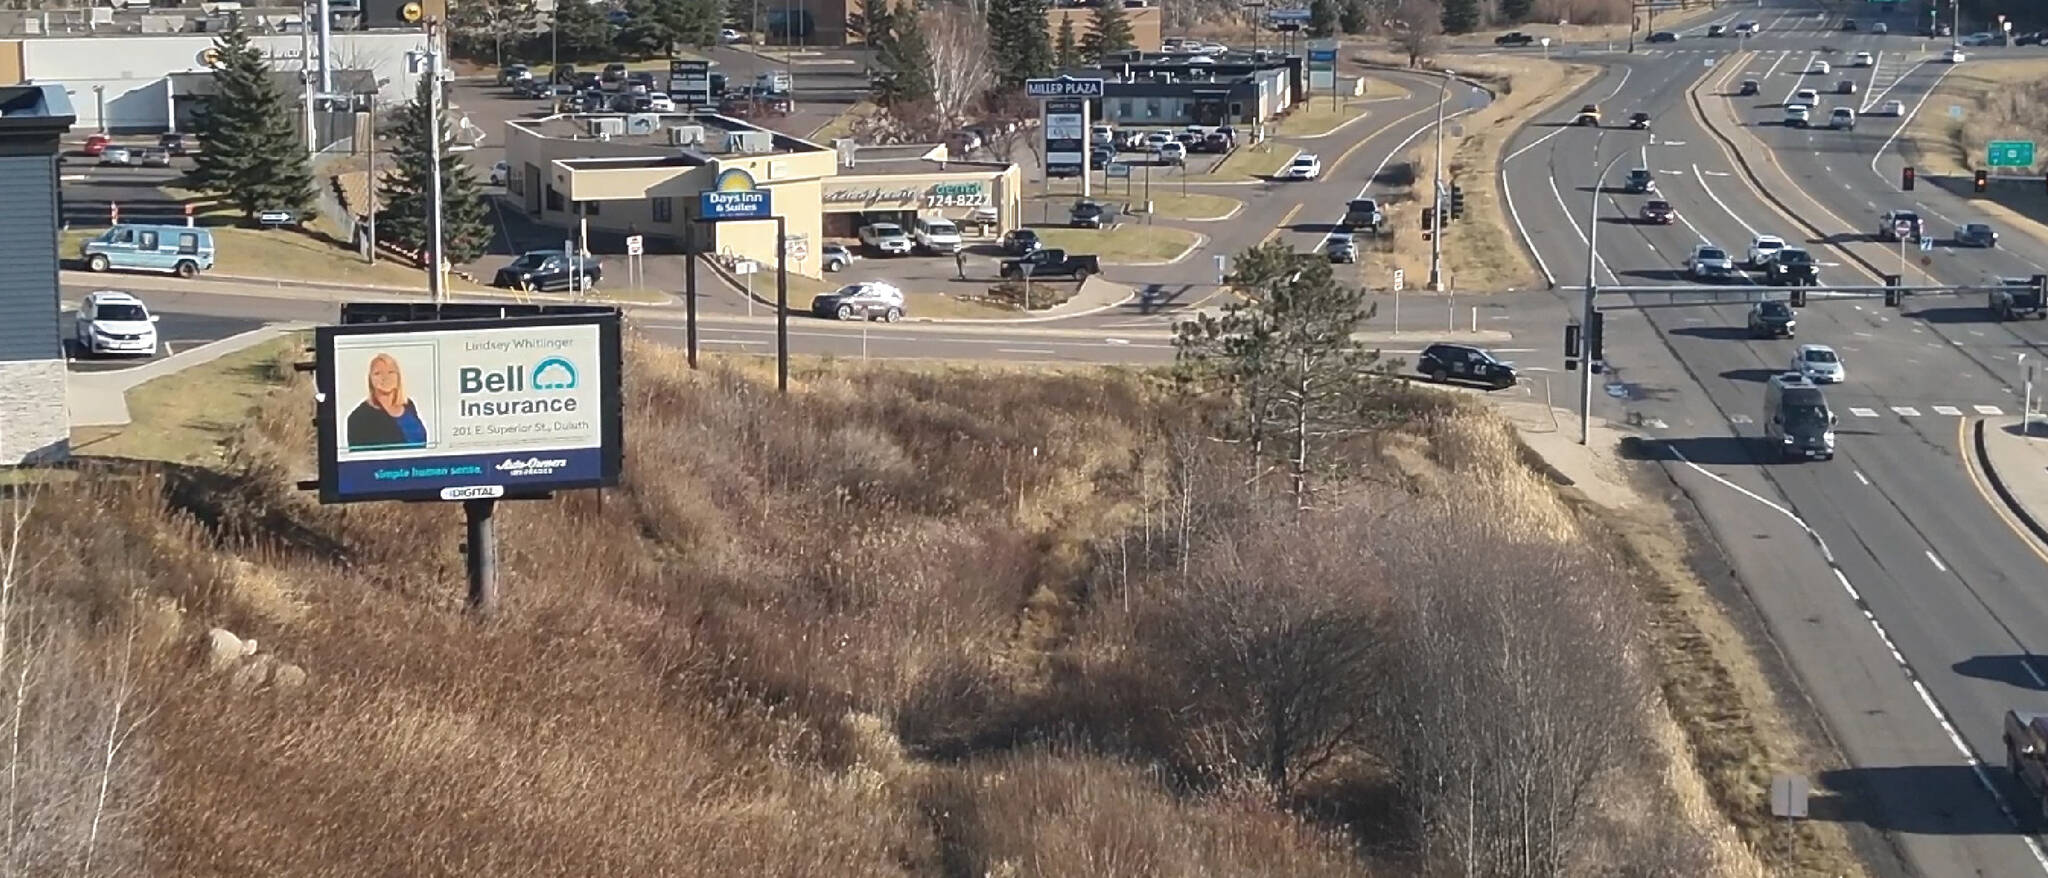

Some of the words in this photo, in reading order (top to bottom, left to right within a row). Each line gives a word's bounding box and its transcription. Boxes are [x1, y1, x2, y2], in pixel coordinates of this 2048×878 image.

[1028, 83, 1063, 94] MILLER
[1065, 83, 1098, 94] PLAZA
[709, 193, 740, 203] Days
[742, 192, 763, 203] Inn
[725, 203, 757, 212] Suites
[465, 340, 511, 352] Lindsey
[460, 365, 524, 393] Bell
[460, 397, 577, 416] Insurance
[452, 426, 472, 436] 201
[487, 423, 532, 435] Superior
[554, 420, 589, 431] Duluth
